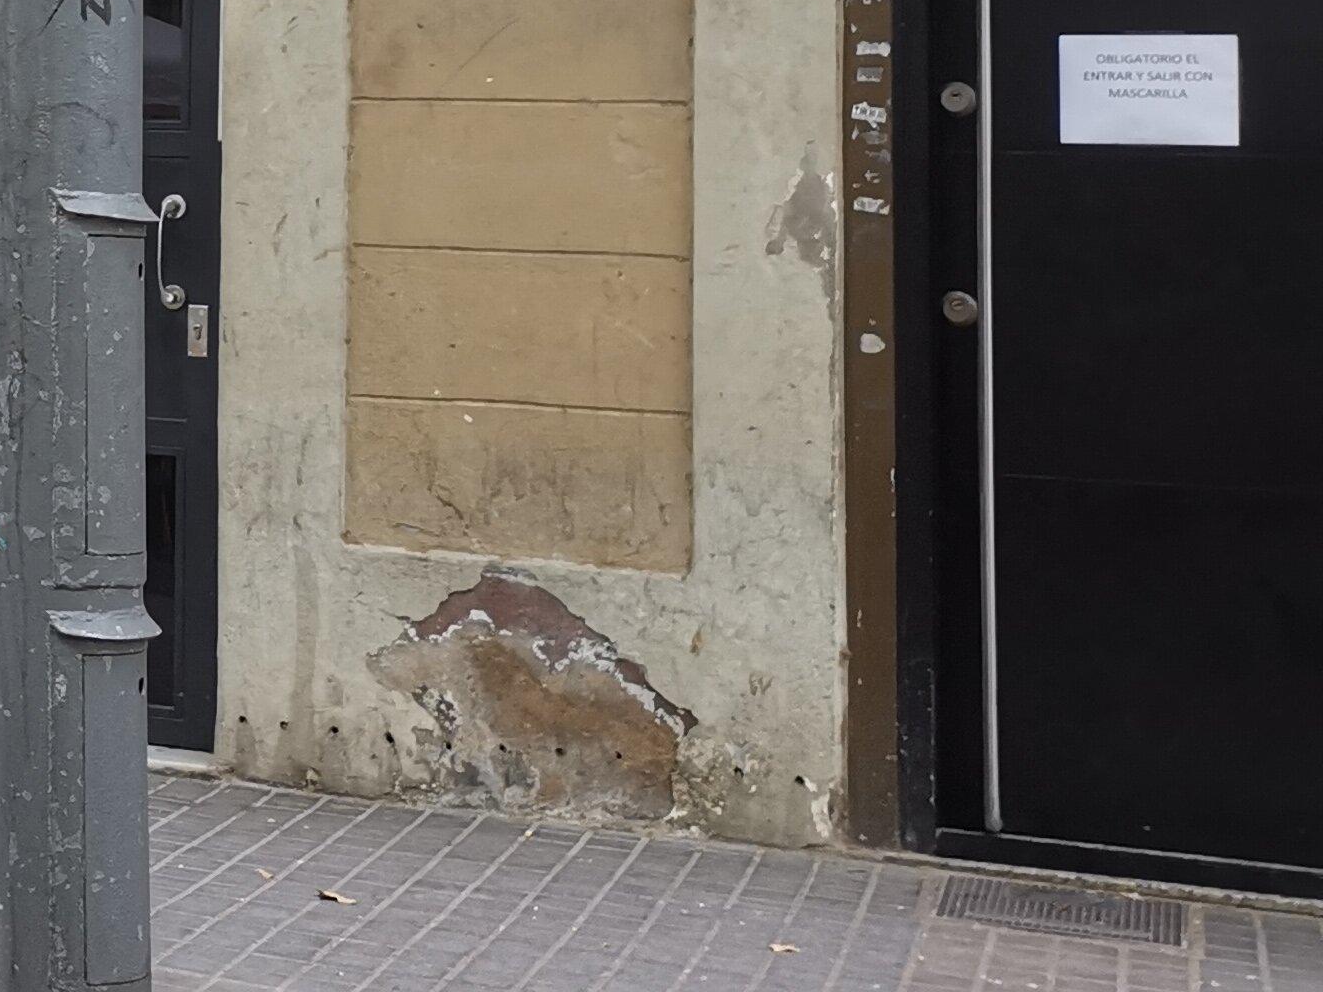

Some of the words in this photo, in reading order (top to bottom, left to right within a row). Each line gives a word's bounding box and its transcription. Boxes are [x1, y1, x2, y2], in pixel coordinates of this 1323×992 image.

[1096, 53, 1183, 65] OBLIGATORIO
[1186, 54, 1200, 65] EL
[1083, 71, 1133, 82] ENTRAR
[1136, 71, 1145, 81] Y
[1146, 71, 1181, 82] SALIR
[1184, 71, 1213, 82] CON
